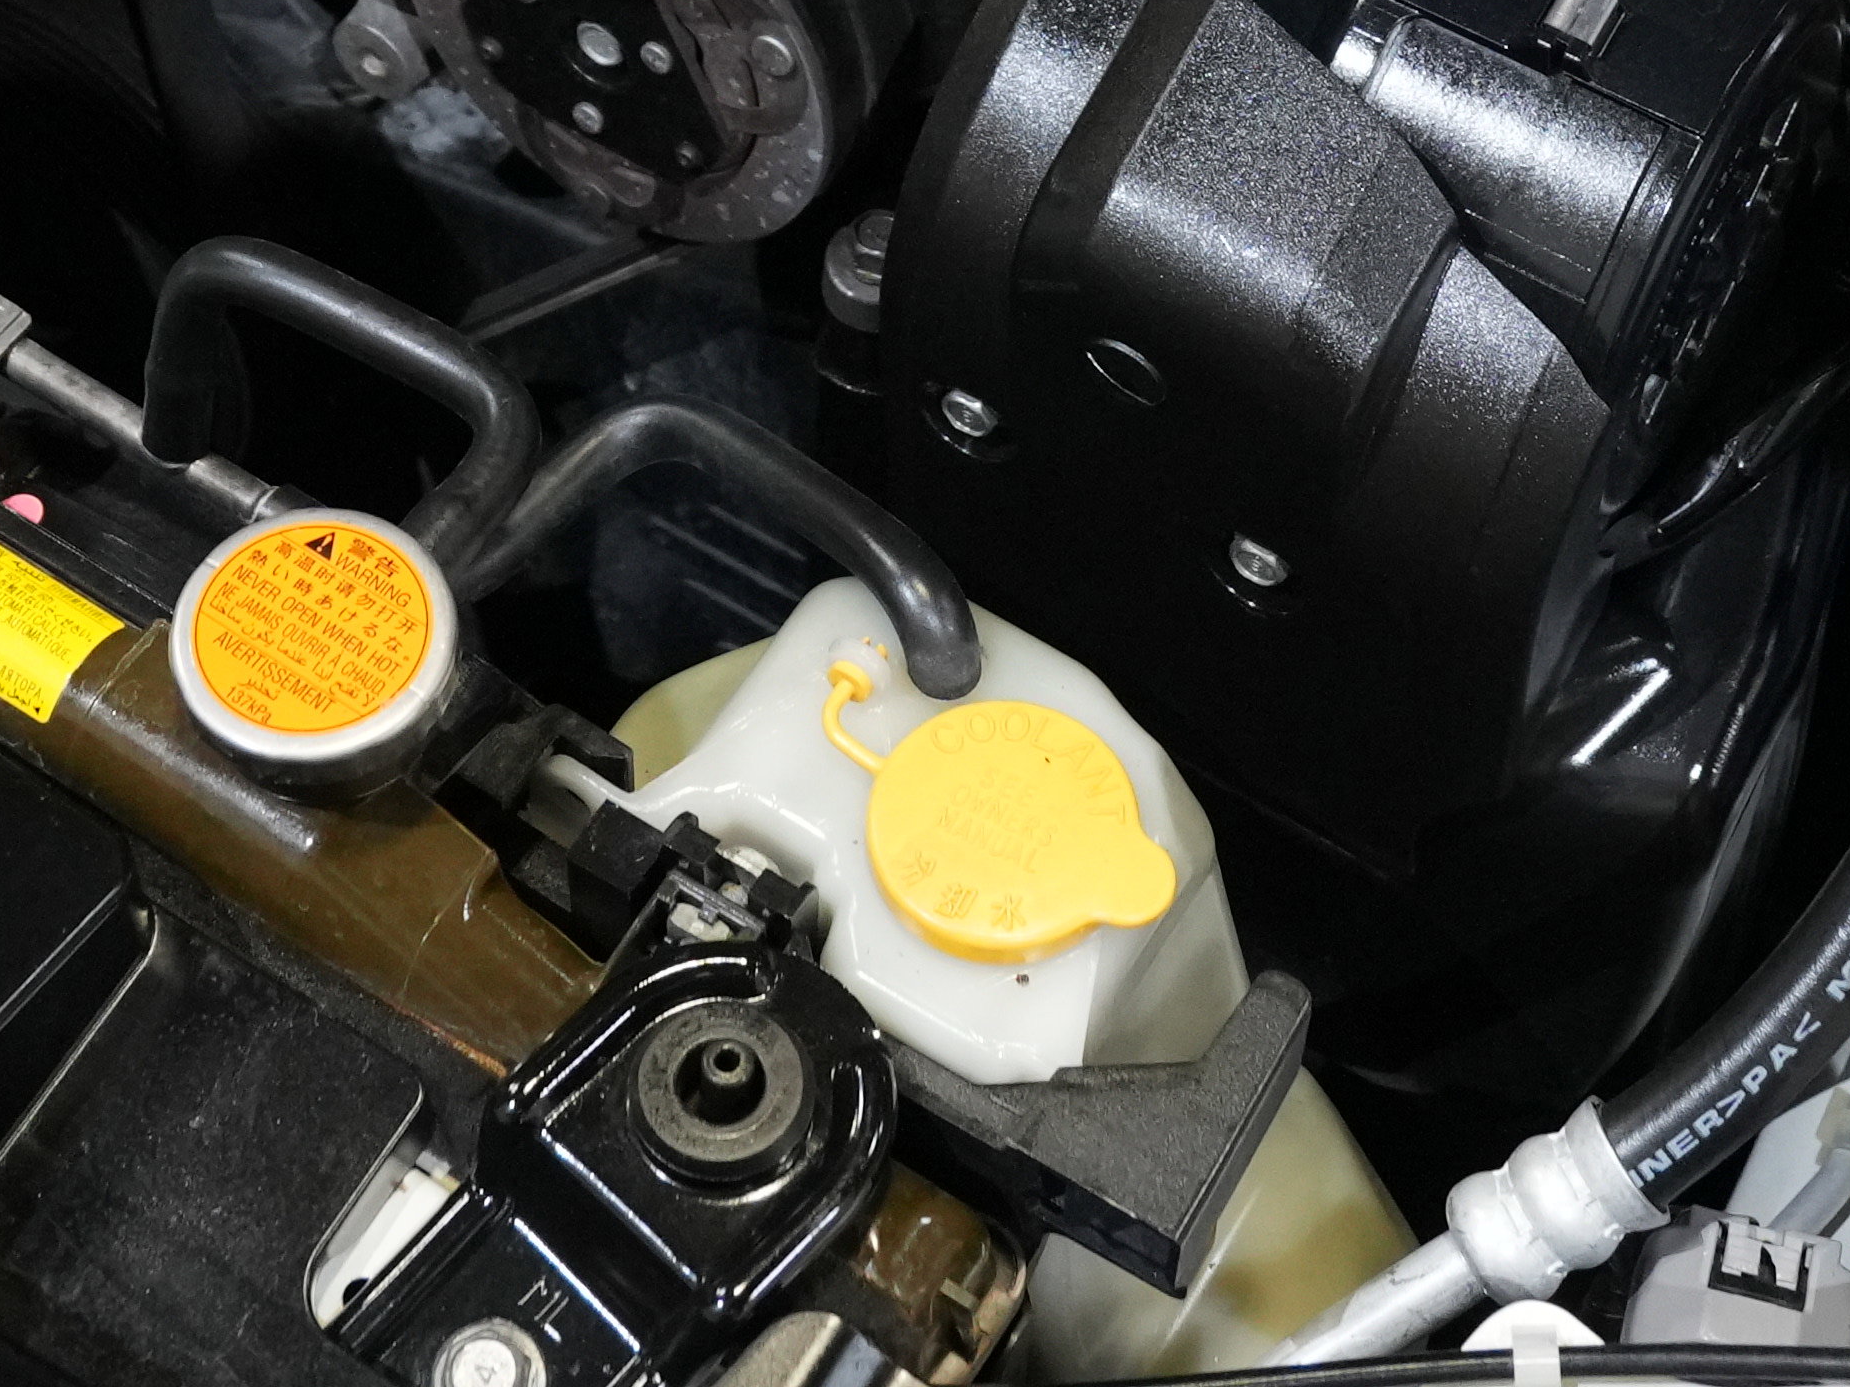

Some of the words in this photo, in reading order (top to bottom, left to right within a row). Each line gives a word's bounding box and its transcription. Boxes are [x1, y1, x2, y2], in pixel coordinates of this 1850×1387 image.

[216, 579, 239, 601] NE
[234, 591, 284, 630] JAMAIS
[280, 620, 331, 661] OUVRIR
[231, 563, 282, 603] NEVER
[280, 593, 323, 629] OPEN
[320, 619, 369, 658] WHEN
[333, 552, 412, 609] WARNING
[212, 628, 336, 715] AVERTISSEMENT
[224, 685, 274, 723] 137kPa
[930, 708, 1126, 825] COOLANT
